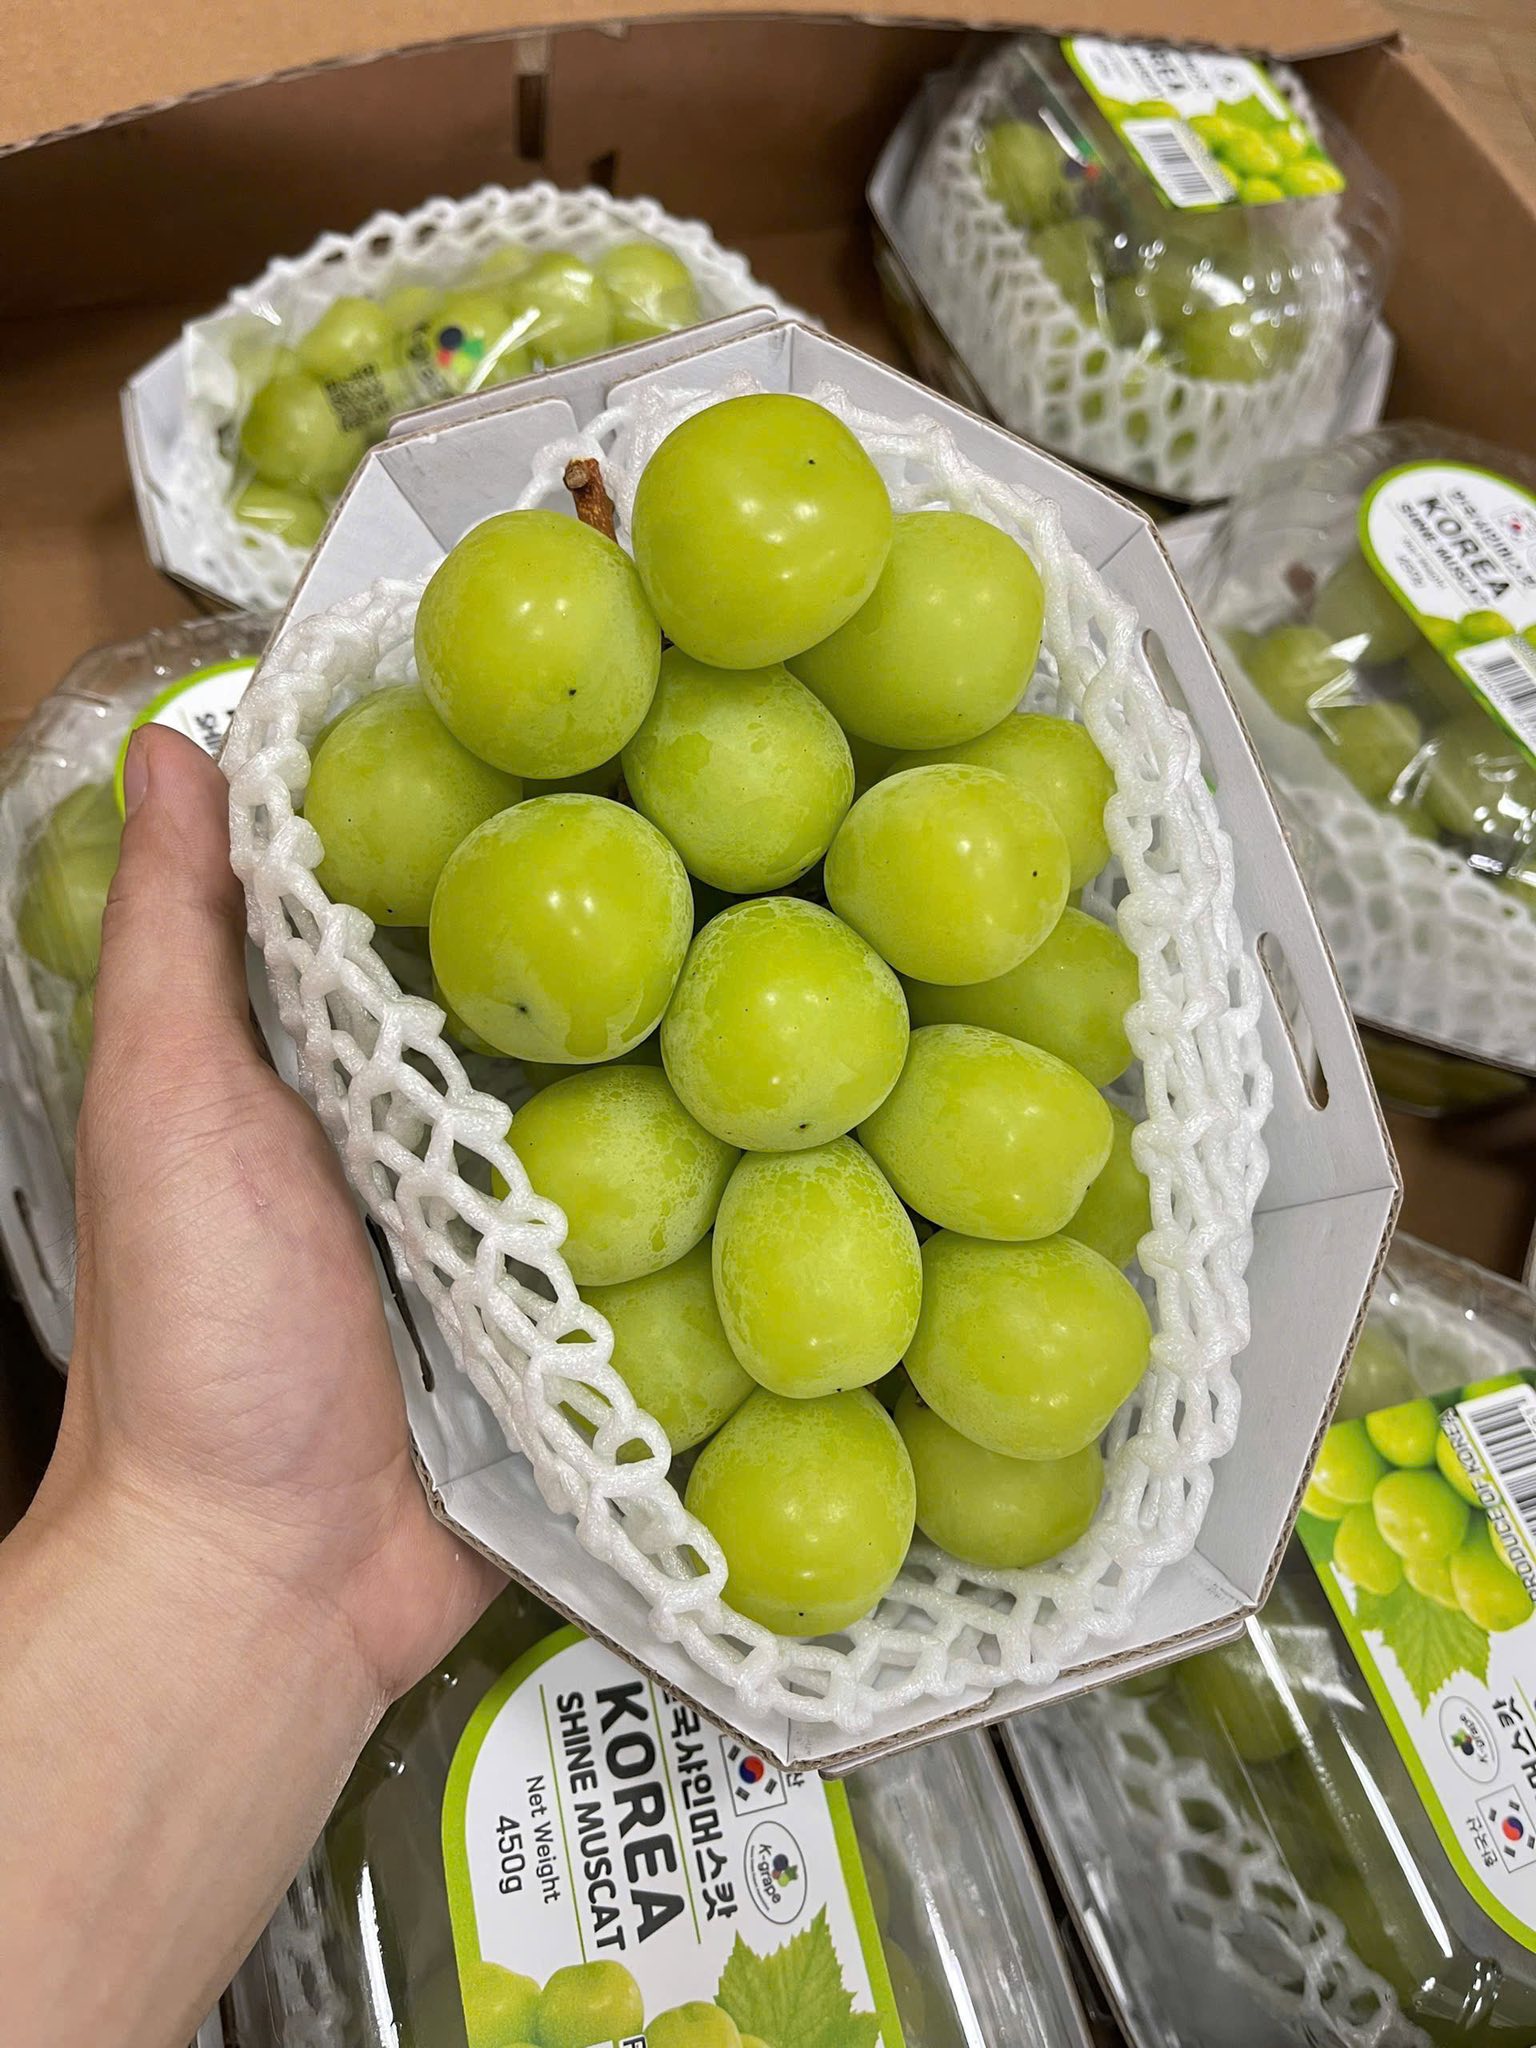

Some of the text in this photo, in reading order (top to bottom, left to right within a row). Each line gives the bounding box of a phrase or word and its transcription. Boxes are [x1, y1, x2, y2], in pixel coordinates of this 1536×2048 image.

[1421, 498, 1510, 597] KOREA
[1440, 1409, 1484, 1476] KOREA
[1471, 1477, 1498, 1507] OF
[525, 1774, 561, 1905] Net Weight
[556, 1691, 627, 1951] SHINE MUSCAT
[595, 1680, 686, 1944] KOREA
[662, 1689, 738, 1922] 국샤인머스캇
[1466, 1816, 1498, 1868] 한국산
[495, 1814, 527, 1895] 450g
[757, 1843, 782, 1905] K-grape
